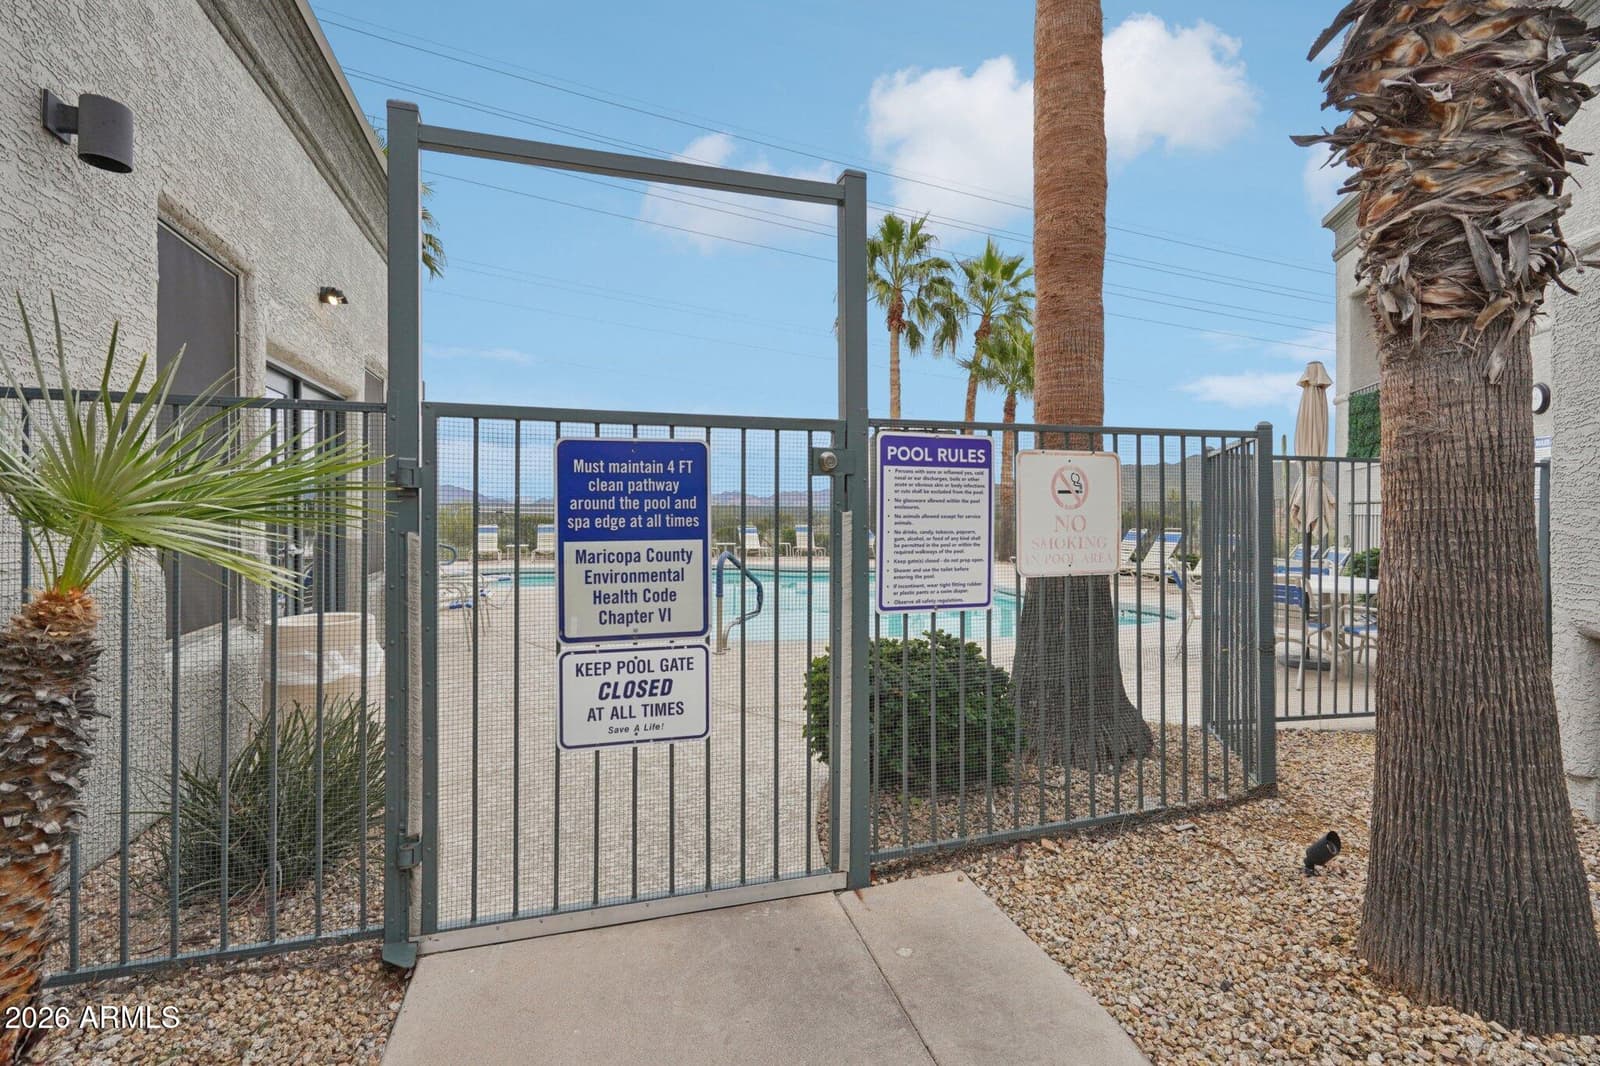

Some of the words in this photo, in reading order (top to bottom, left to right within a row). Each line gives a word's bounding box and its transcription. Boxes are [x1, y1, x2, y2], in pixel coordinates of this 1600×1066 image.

[887, 446, 932, 461] POOL
[938, 448, 985, 463] RULES
[573, 459, 604, 473] Must
[608, 460, 663, 474] maintain
[667, 461, 675, 473] 4
[679, 460, 693, 474] FT
[588, 479, 623, 492] clean
[628, 479, 679, 494] pathway
[570, 497, 615, 510] around
[620, 497, 639, 509] the
[644, 496, 670, 512] pool
[674, 496, 696, 509] and
[568, 517, 590, 531] spa
[595, 515, 625, 530] edge
[630, 516, 642, 527] at
[647, 515, 661, 527] all
[665, 514, 699, 527] times
[1055, 515, 1086, 532] NO
[1032, 536, 1106, 550] SMOKING
[576, 550, 640, 566] Maricopa
[646, 548, 693, 564] County
[1045, 553, 1075, 564] POOL
[1083, 552, 1113, 563] AREA
[585, 568, 685, 584] Environmental
[593, 590, 638, 605] Health
[643, 588, 677, 602] Code
[599, 609, 654, 626] Chapter
[659, 609, 671, 622] VI
[576, 662, 611, 677] KEEP
[617, 660, 654, 674] POOL
[660, 657, 694, 672] GATE
[599, 679, 673, 700] CLOSED
[587, 707, 604, 722] AT
[610, 705, 636, 720] ALL
[641, 701, 684, 717] TIMES
[608, 726, 629, 734] Save
[644, 723, 664, 731] Life!
